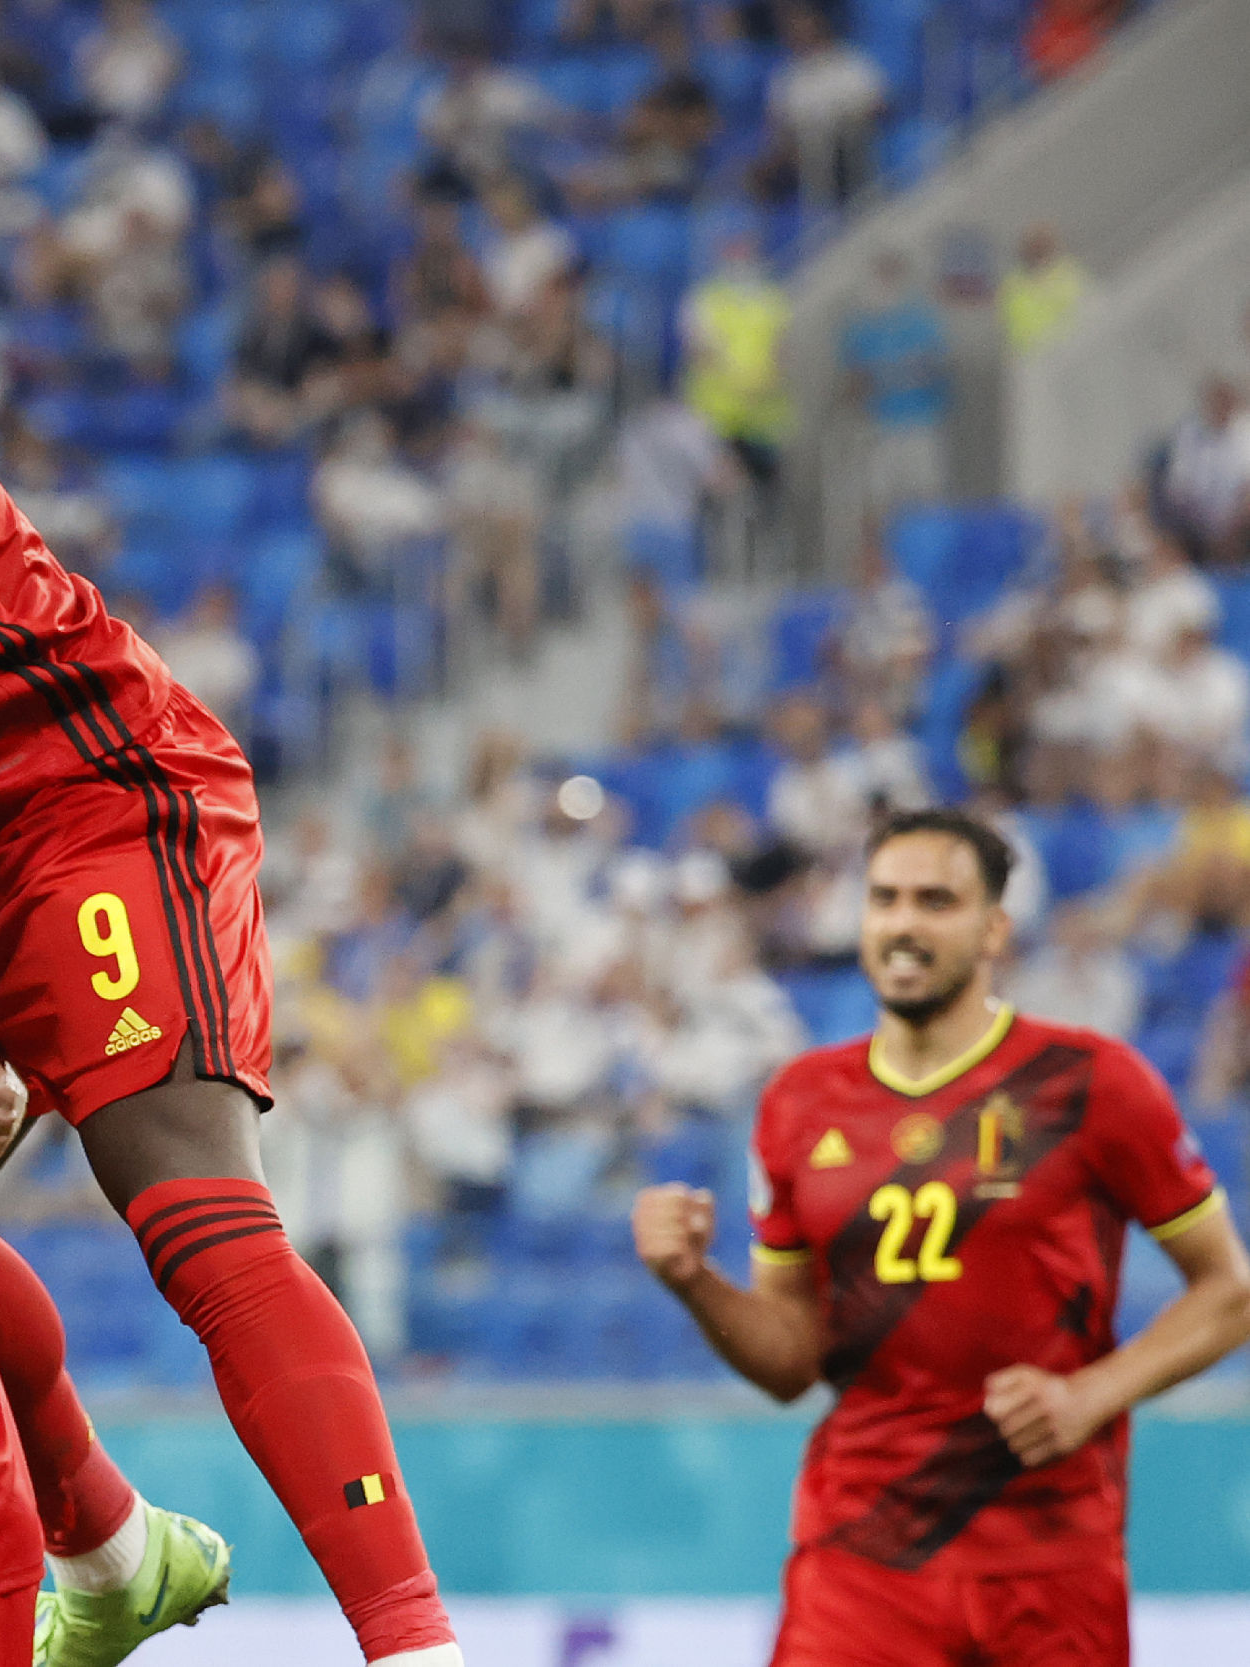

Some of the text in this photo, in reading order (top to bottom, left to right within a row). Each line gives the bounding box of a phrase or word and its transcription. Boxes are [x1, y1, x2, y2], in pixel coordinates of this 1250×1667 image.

[77, 892, 140, 1000] 9
[104, 1026, 162, 1056] adidas
[869, 1182, 963, 1284] 22
